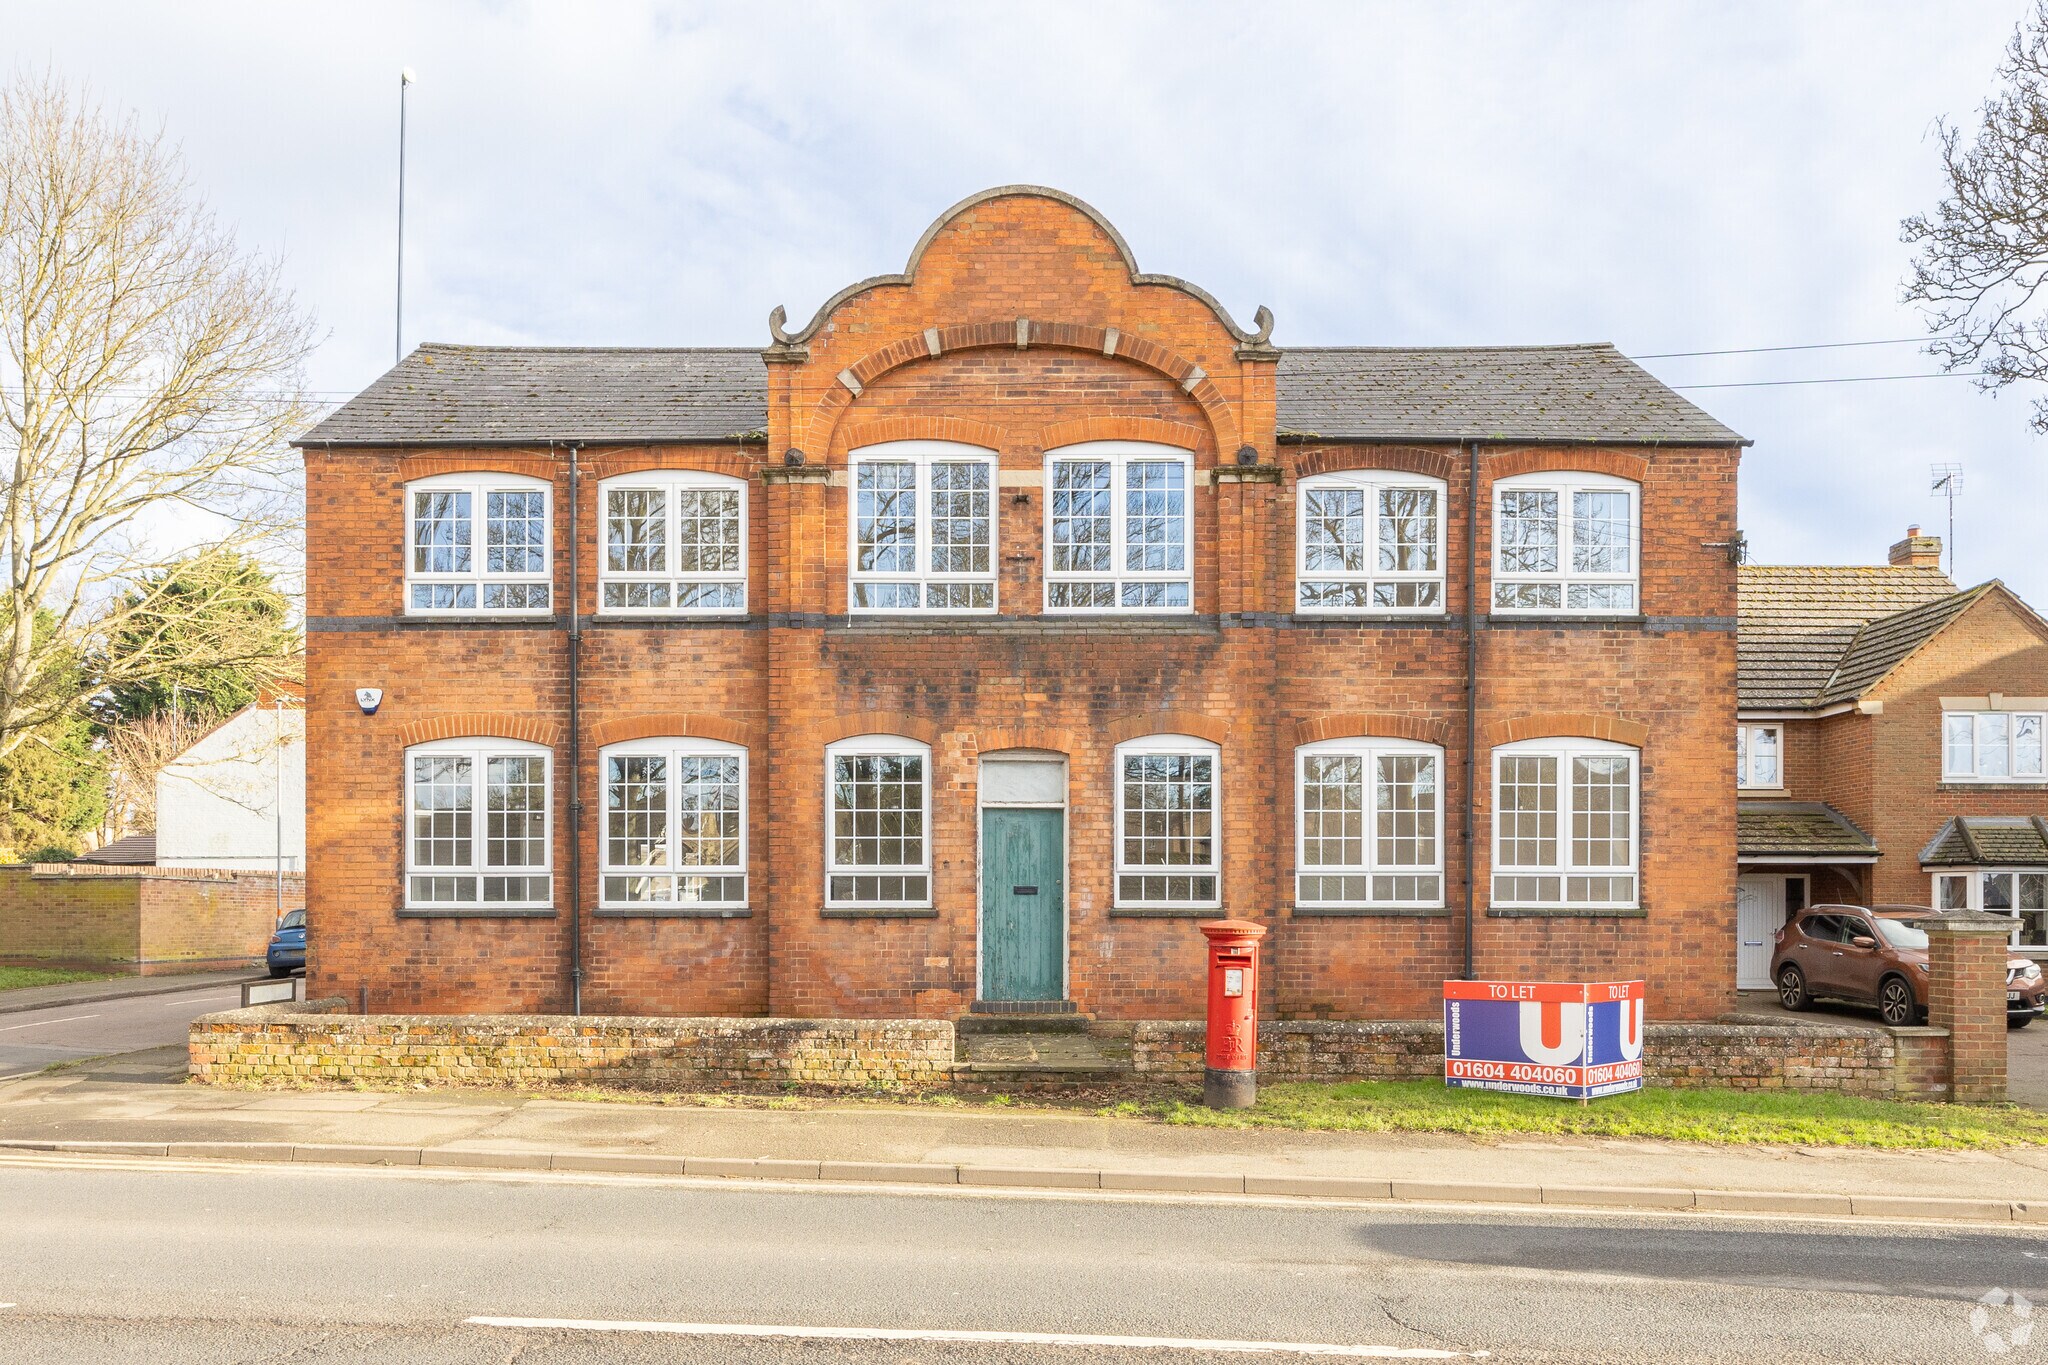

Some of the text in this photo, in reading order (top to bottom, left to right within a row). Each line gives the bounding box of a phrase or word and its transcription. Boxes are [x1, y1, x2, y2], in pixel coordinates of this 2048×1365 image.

[1488, 985, 1536, 999] TO LET
[1608, 984, 1630, 998] TO LET
[1450, 1001, 1461, 1056] Underwoods
[1453, 1061, 1577, 1084] 01604 404060
[1588, 1062, 1640, 1084] 01604 404060
[1461, 1079, 1568, 1096] www.underwoods.co.uk
